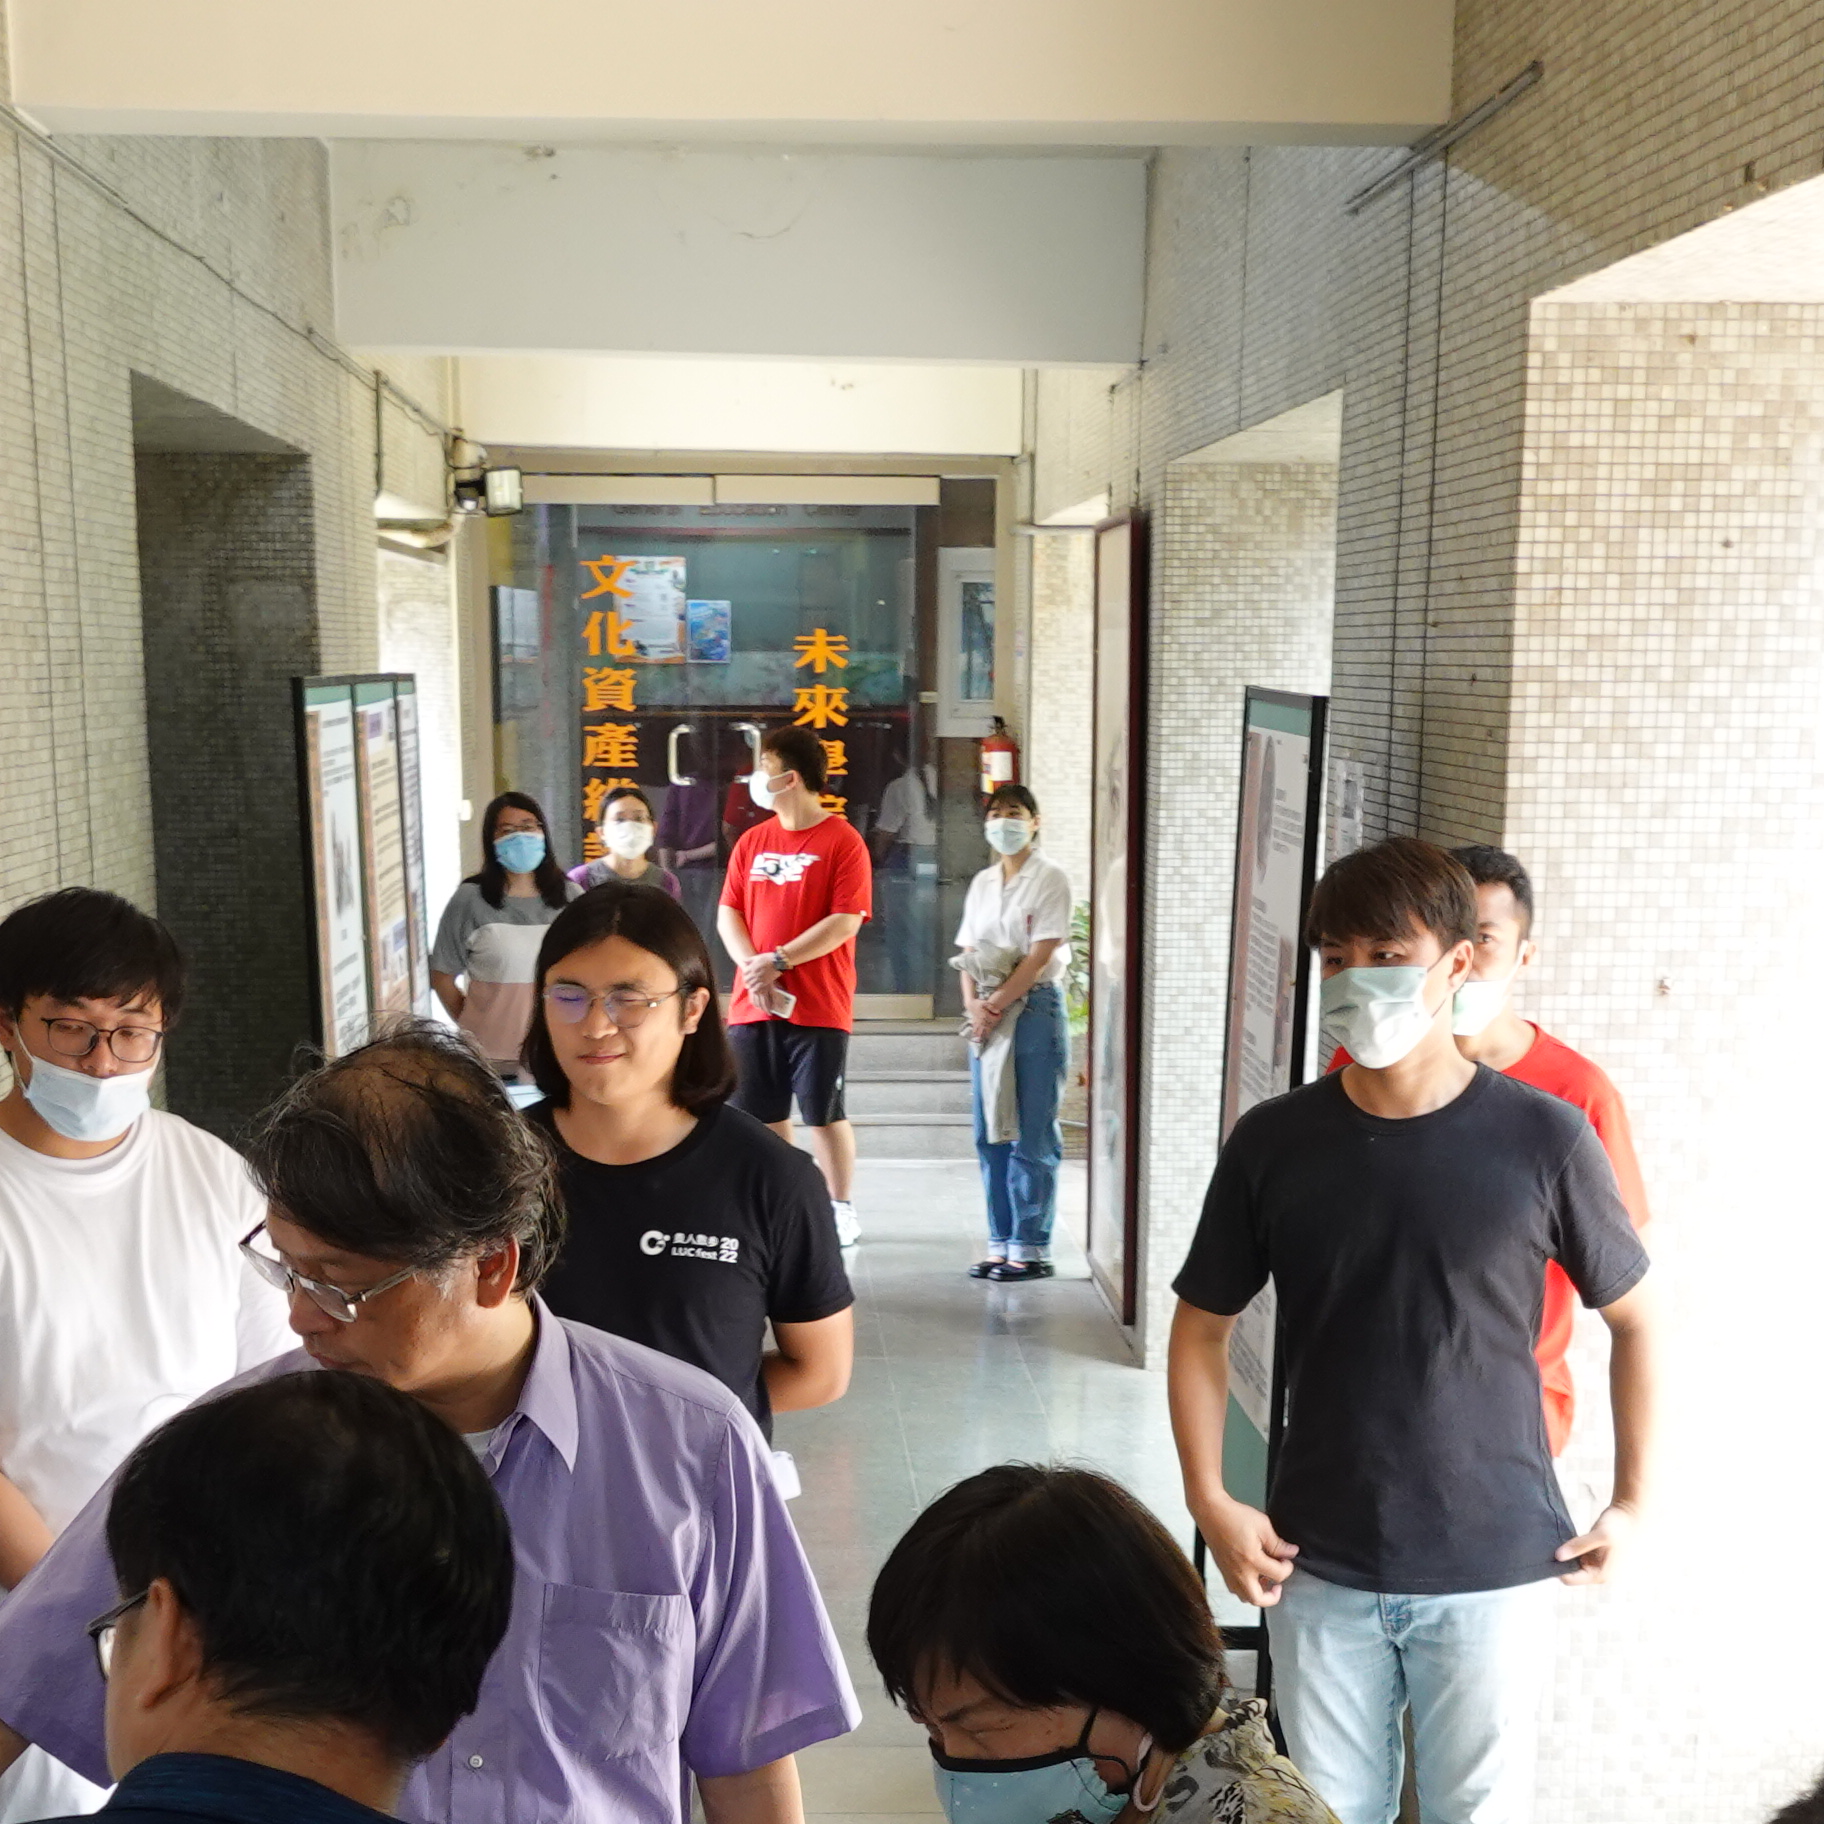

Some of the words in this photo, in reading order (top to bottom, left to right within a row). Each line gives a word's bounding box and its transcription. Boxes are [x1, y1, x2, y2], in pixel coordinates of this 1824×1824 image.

[719, 1237, 739, 1250] 20
[671, 1246, 718, 1260] LUCfest
[719, 1250, 738, 1263] 22
